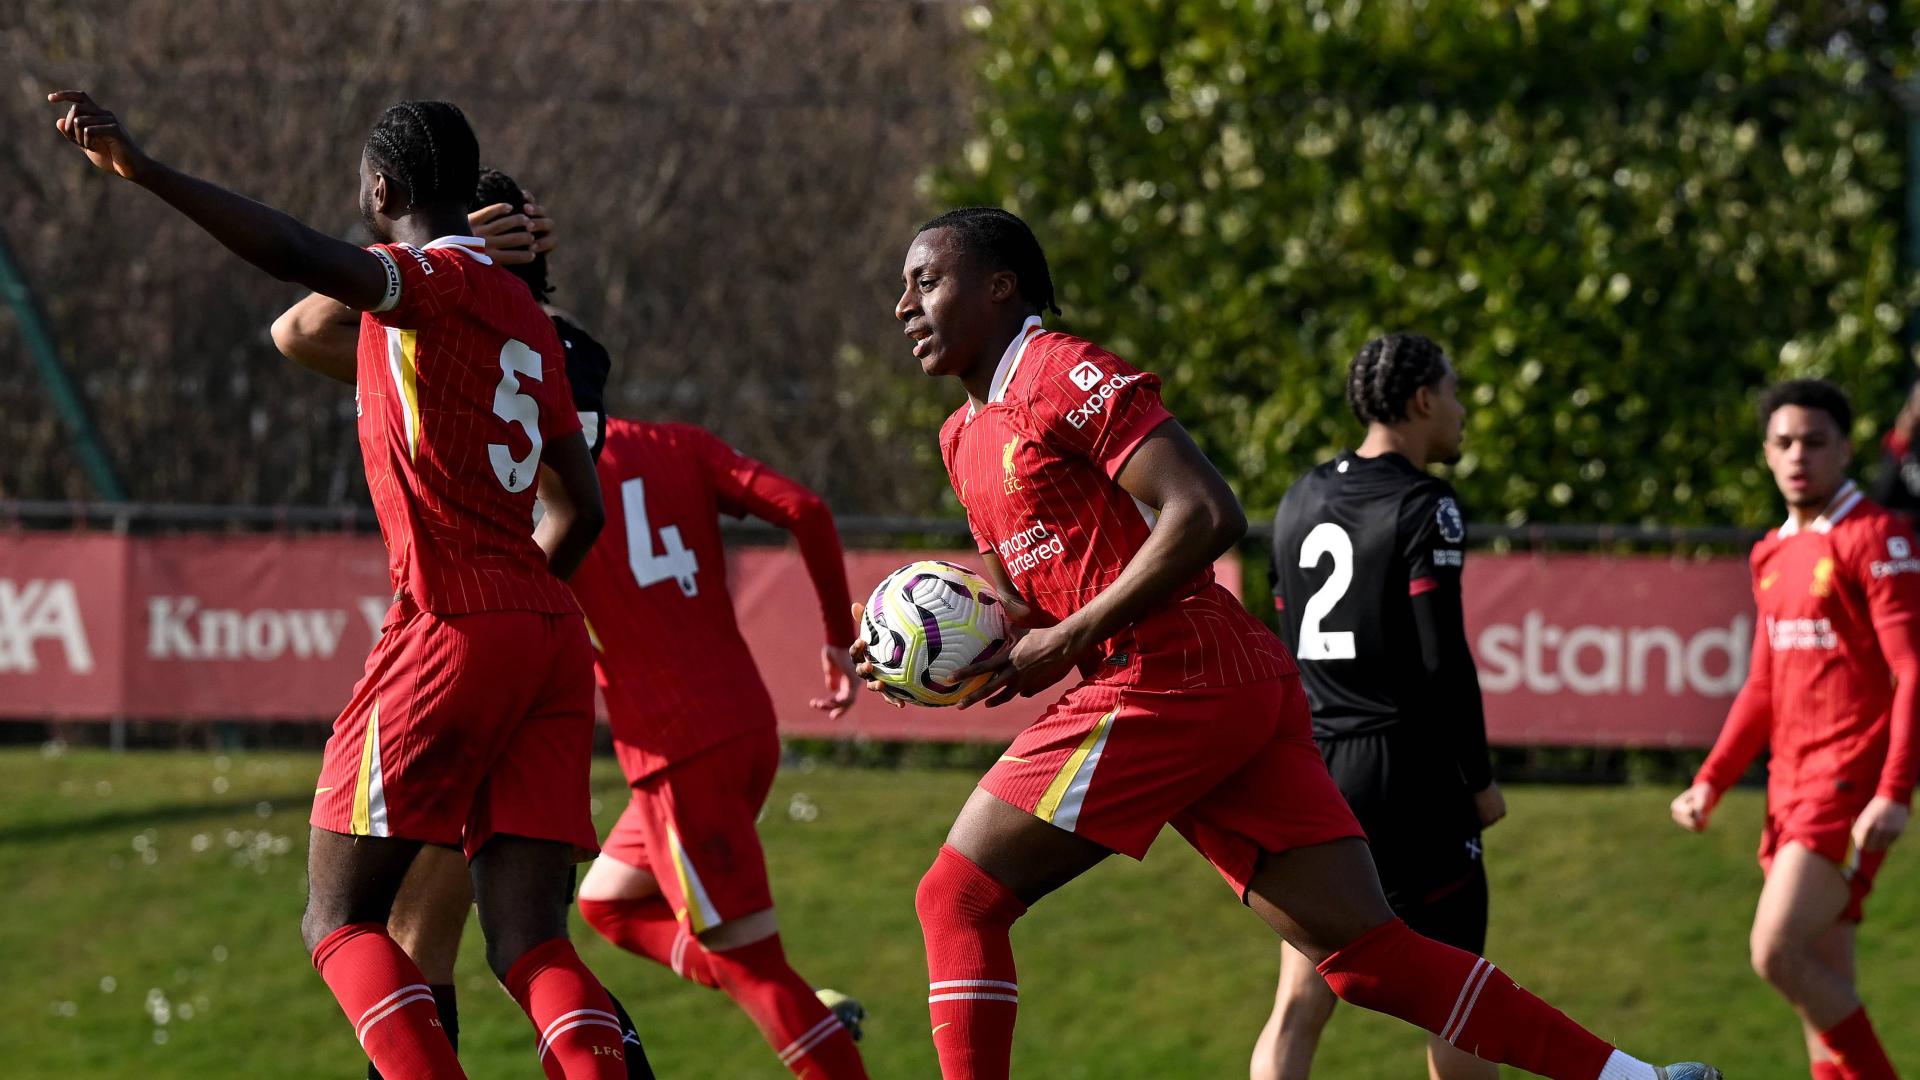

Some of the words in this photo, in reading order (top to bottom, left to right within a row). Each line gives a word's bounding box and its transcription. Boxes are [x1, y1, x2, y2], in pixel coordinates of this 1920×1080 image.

[371, 248, 400, 297] aptain
[488, 338, 543, 493] 5
[621, 476, 699, 597] 4
[999, 519, 1049, 561] andard
[1007, 533, 1065, 579] artered
[0, 578, 96, 674] XA
[147, 596, 347, 660] Know
[1296, 522, 1356, 661] 2
[1477, 608, 1749, 696] stand
